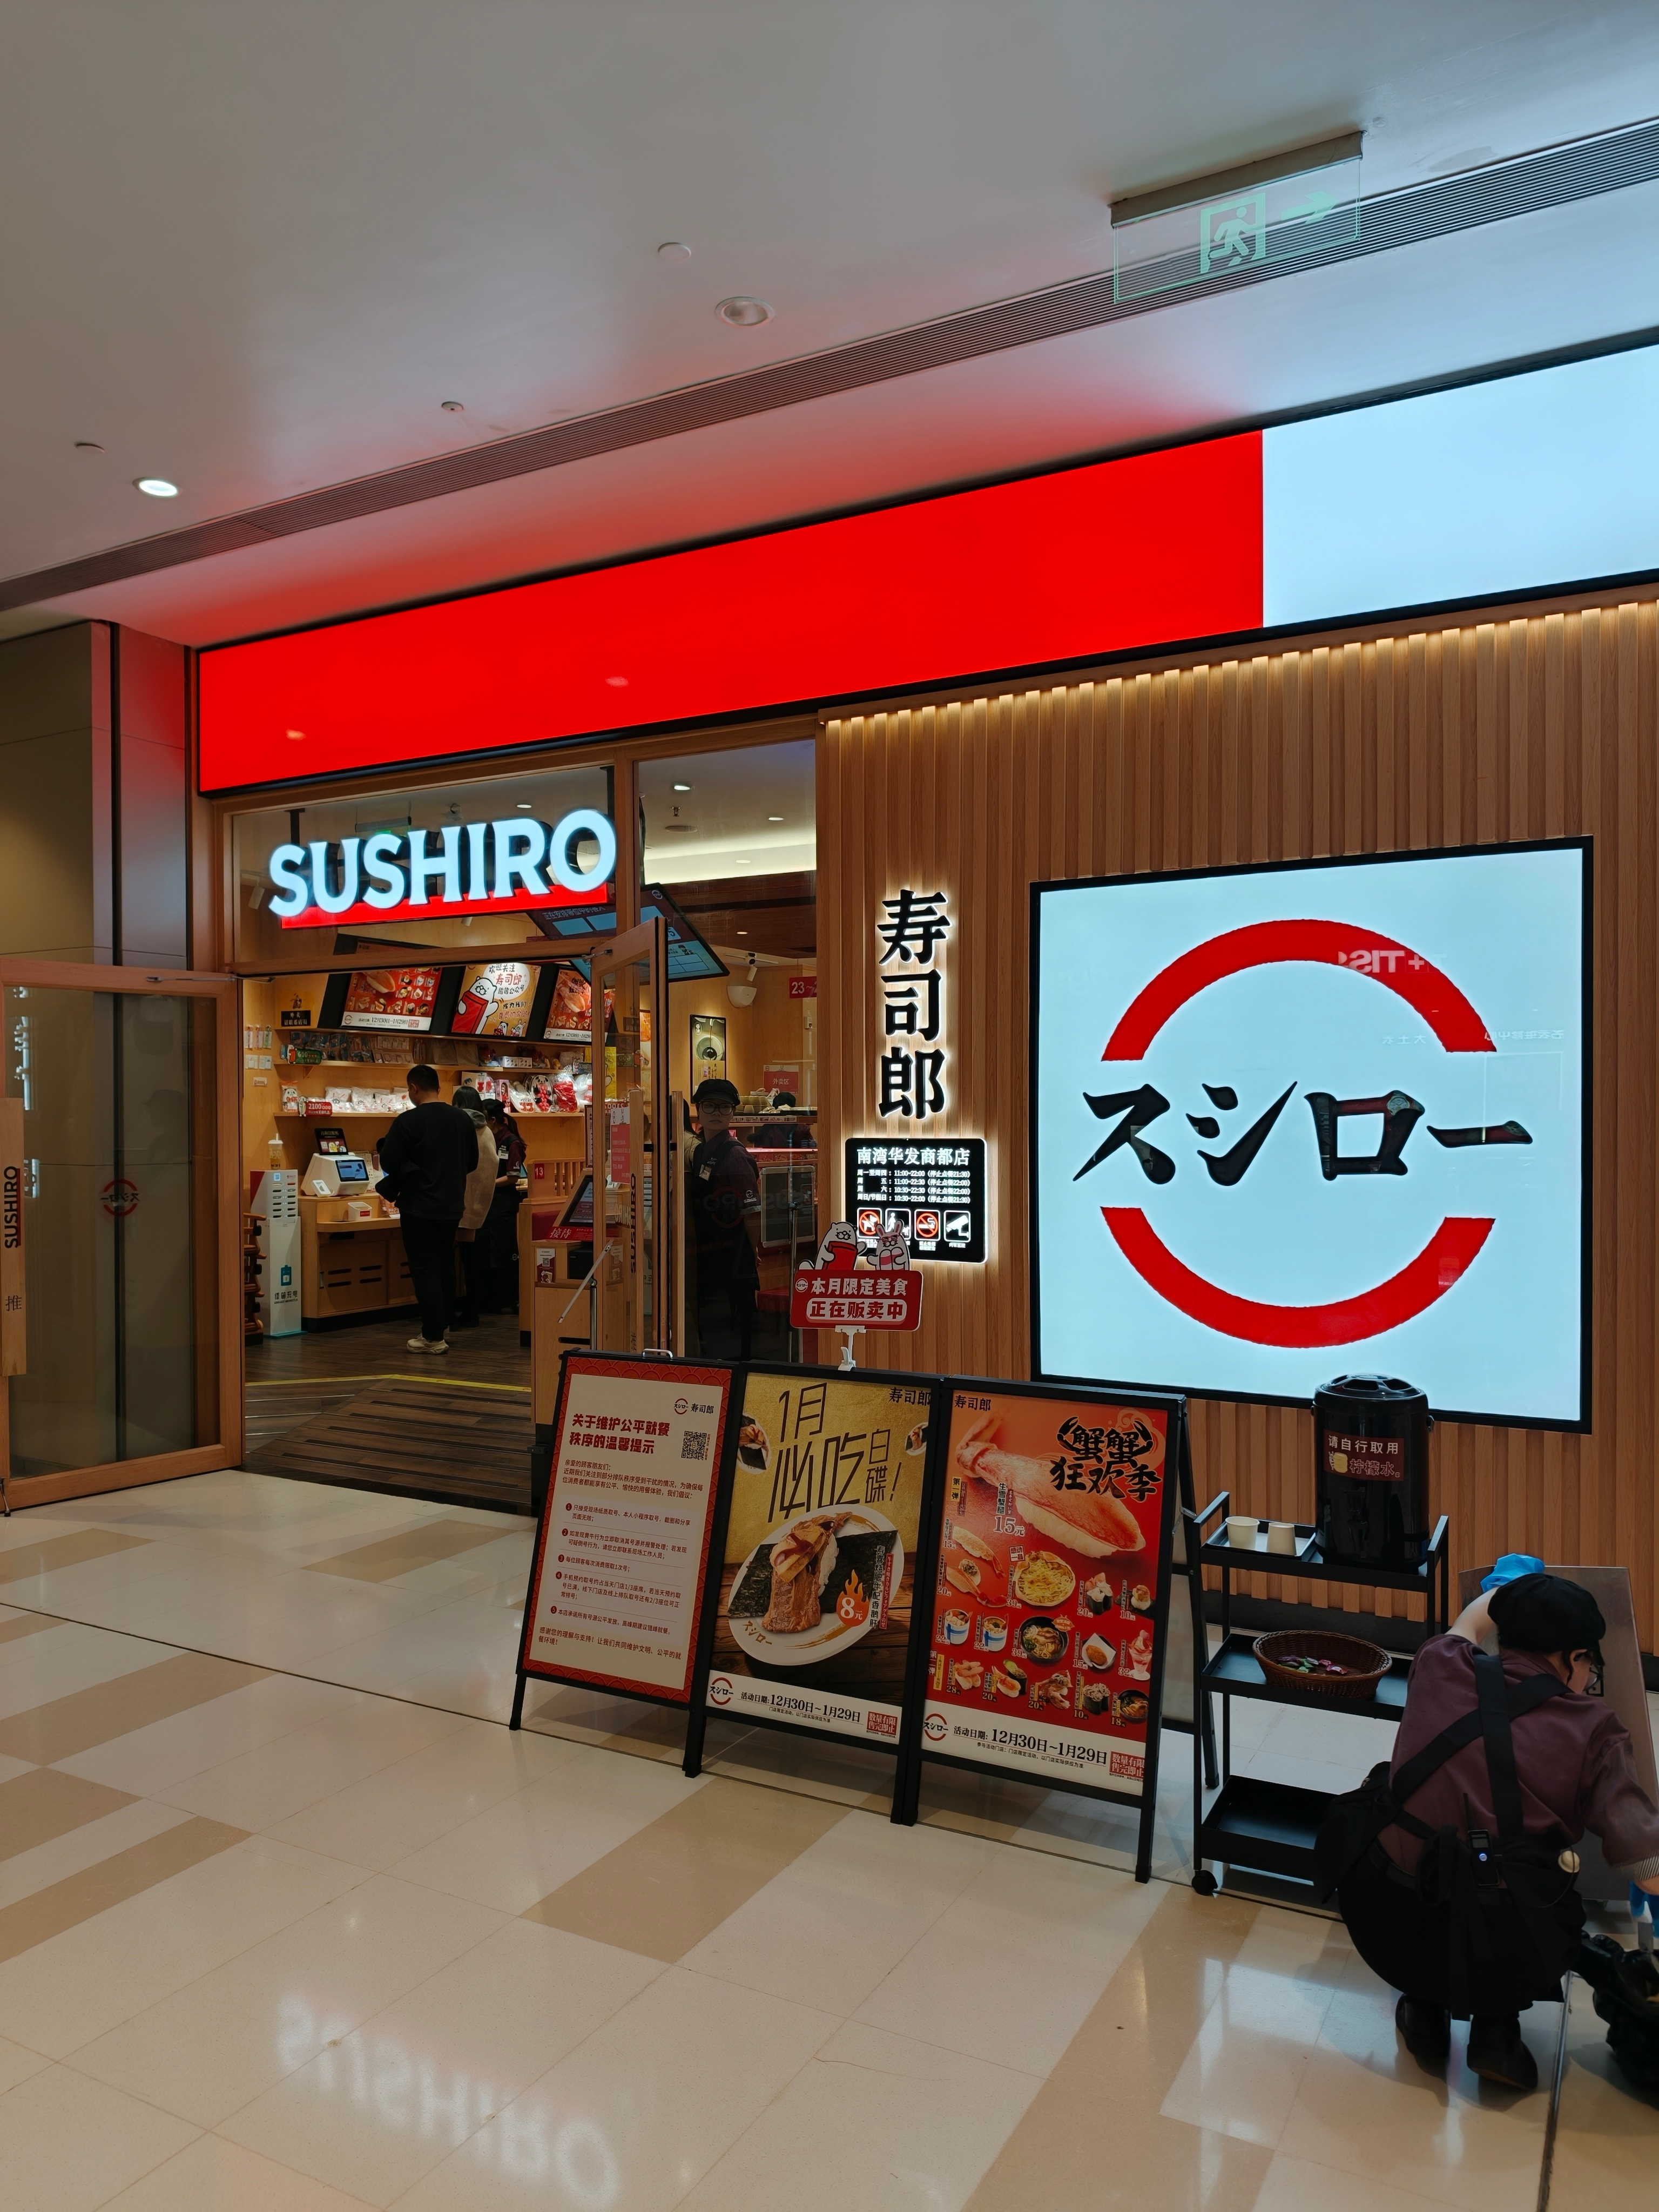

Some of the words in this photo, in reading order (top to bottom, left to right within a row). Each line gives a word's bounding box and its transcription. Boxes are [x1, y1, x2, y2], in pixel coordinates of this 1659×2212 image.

[269, 810, 617, 917] SUSHIRO
[489, 963, 515, 974] 欢迎关注
[496, 973, 522, 986] 寿司郎
[498, 984, 524, 995] 微信公众号
[877, 888, 951, 1120] 寿司郎
[1073, 1081, 1533, 1186] スシロー
[857, 1147, 970, 1166] 南湾华发商都店
[535, 1166, 543, 1176] 13
[4, 1165, 18, 1250] SUSHIRO
[549, 1228, 572, 1239] 接待
[811, 1278, 908, 1296] 本月限定美食
[5, 1296, 22, 1311] 推
[810, 1301, 903, 1320] 正在贩卖中
[888, 1387, 932, 1407] 寿司郎
[954, 1394, 992, 1412] 寿司郎
[691, 1403, 714, 1414] 寿司郎
[778, 1382, 828, 1443] 1月
[572, 1413, 670, 1437] 关于维护公平就餐
[569, 1432, 655, 1454] 秩序的温馨提示
[1071, 1422, 1142, 1466] 蟹蟹
[1328, 1435, 1398, 1454] 请自行取用
[565, 1459, 611, 1471] 亲爱的顾客朋友们：
[1350, 1459, 1395, 1476] 柠檬水
[563, 1468, 703, 1492] 近期我们关注到部分排队秩序受到干扰的情况，为确保每
[767, 1433, 867, 1523] 必吃
[1049, 1455, 1162, 1503] 狂欢季
[952, 1478, 960, 1500] 第一弹
[572, 1513, 594, 1522] 页面无效；
[993, 1515, 1025, 1536] 15元
[840, 1597, 864, 1620] 8元
[743, 1620, 773, 1646] スシロー
[928, 1650, 937, 1675] 第二弹
[709, 1686, 734, 1696] スシロー
[741, 1691, 770, 1704] 活动日期：
[770, 1694, 861, 1723] 12月30日~1月29日
[868, 1720, 895, 1734] 售完即止
[869, 1712, 896, 1725] 数量有限
[923, 1721, 948, 1731] スシロー
[953, 1725, 988, 1741] 活动日期：
[992, 1729, 1107, 1765] 12月30日~1月29日
[1111, 1753, 1145, 1769] 数量有限
[1111, 1762, 1144, 1777] 售完即止
